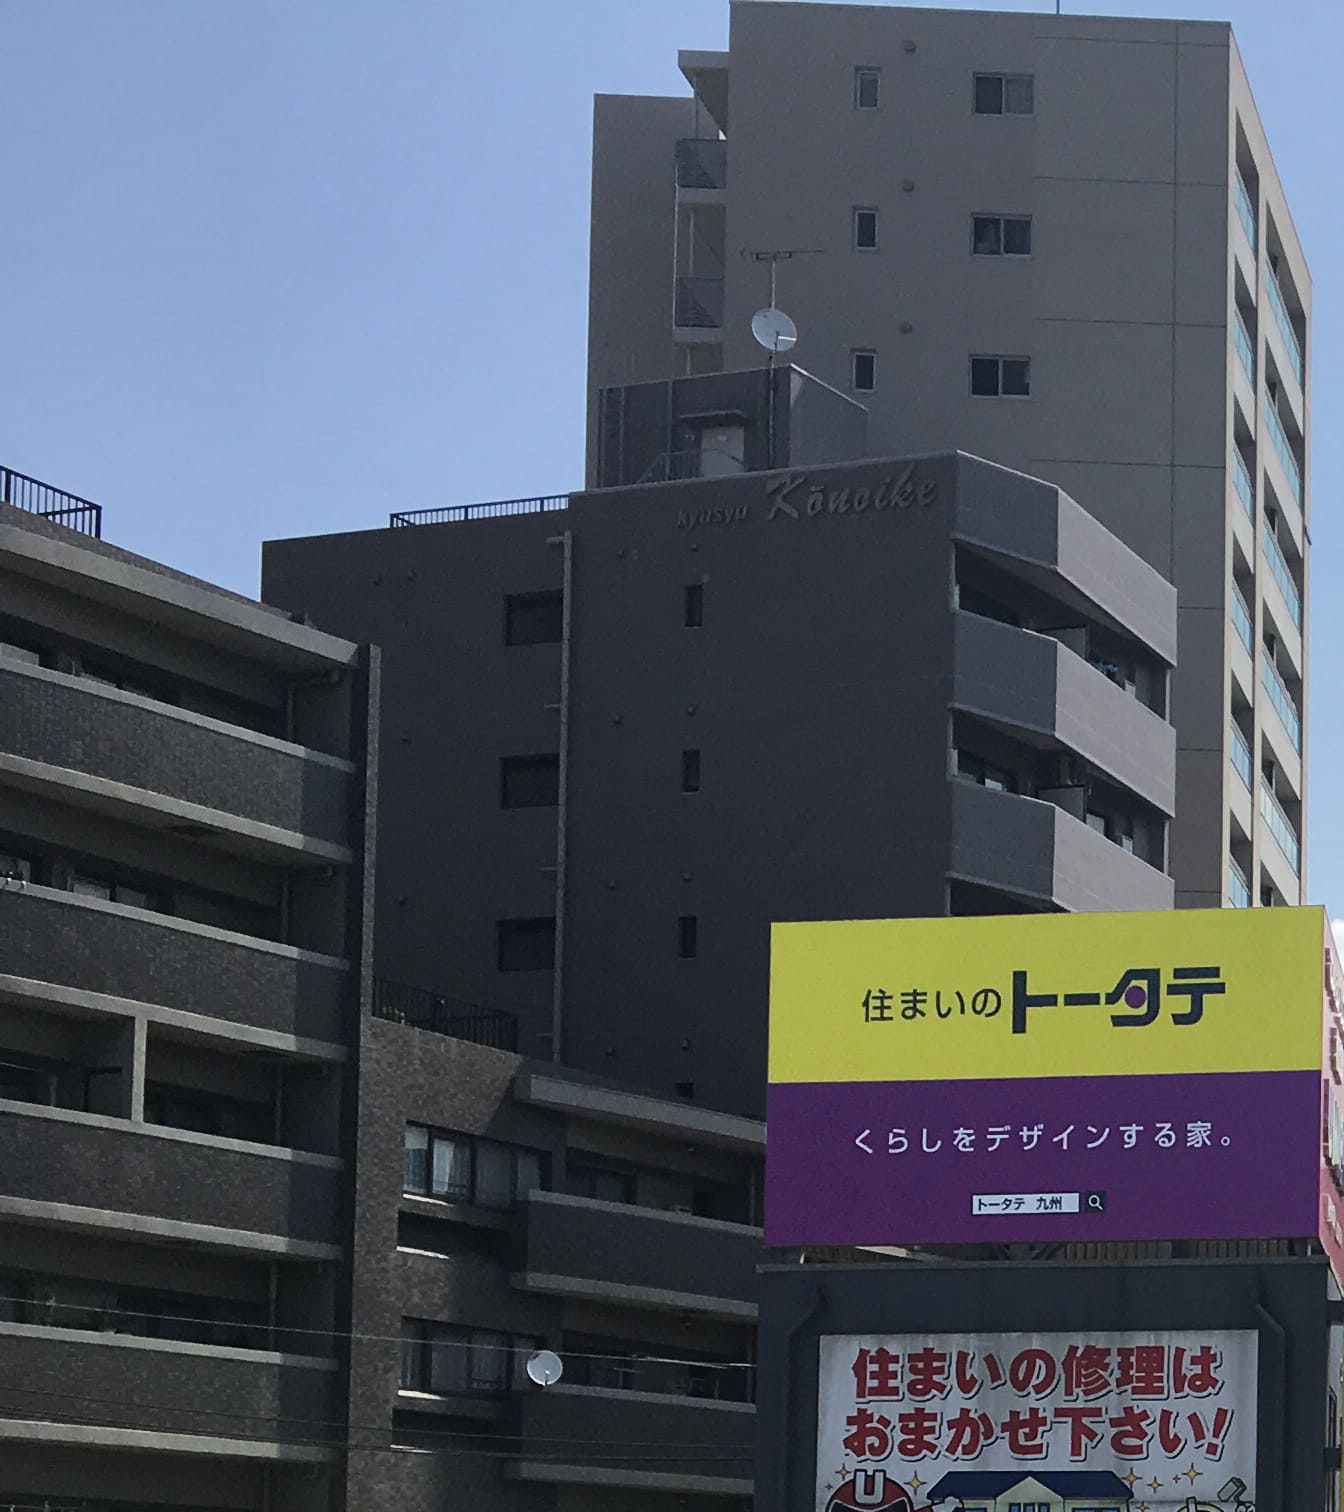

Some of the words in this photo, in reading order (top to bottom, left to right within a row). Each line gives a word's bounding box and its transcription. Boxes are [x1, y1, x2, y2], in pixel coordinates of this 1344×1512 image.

[862, 966, 1226, 1034] 住まいのトータテ
[854, 1120, 1232, 1155] くらしをデザインする家。
[976, 1197, 1025, 1213] トータテ
[1036, 1195, 1062, 1212] 九州
[852, 1344, 1224, 1402] 住まいの修理は
[853, 1468, 885, 1504] U
